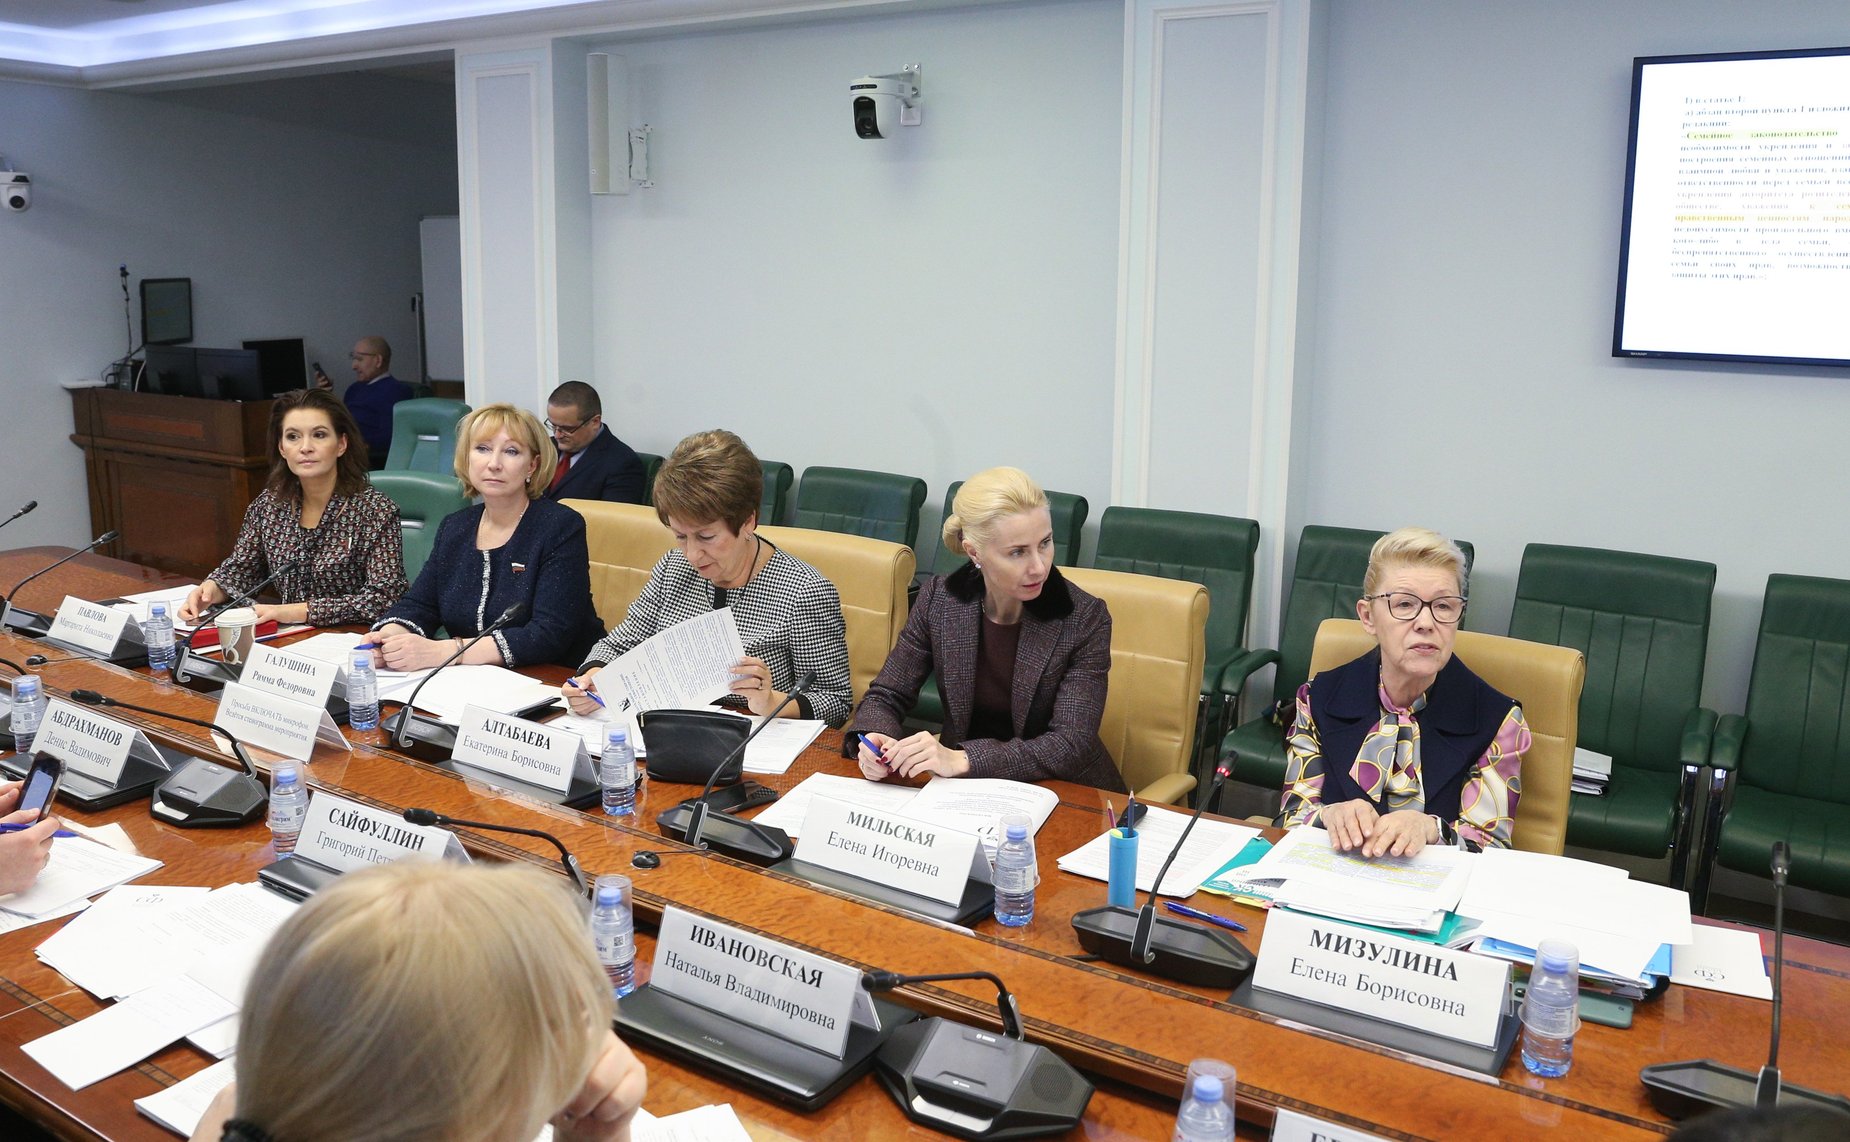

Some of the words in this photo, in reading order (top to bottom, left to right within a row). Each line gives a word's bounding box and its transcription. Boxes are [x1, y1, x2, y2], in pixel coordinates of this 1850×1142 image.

[78, 606, 107, 623] ПАВЛОВА
[252, 670, 275, 685] Римма
[276, 677, 316, 697] Федоровна
[265, 653, 316, 677] ГАЛУШИНА
[51, 710, 123, 746] АБДРАХМАНОВ
[481, 718, 551, 750] АЛТАБАЕВА
[44, 730, 68, 750] Денис
[68, 739, 112, 768] Вадимович
[463, 734, 508, 759] Екатерина
[511, 749, 561, 776] Борисовна
[316, 830, 366, 860] Григорий
[328, 807, 425, 852] САЙФУЛЛИН
[846, 811, 936, 848] МИЛЬСКАЯ
[827, 830, 867, 855] Елена
[872, 843, 940, 877] Игоревна
[689, 924, 824, 988] ИВАНОВСКАЯ
[1308, 928, 1459, 982] МИЗУЛИНА
[664, 950, 722, 986] Наталья
[724, 973, 836, 1031] Владимировна
[1290, 957, 1348, 987] Елена
[1356, 973, 1466, 1017] Борисовна
